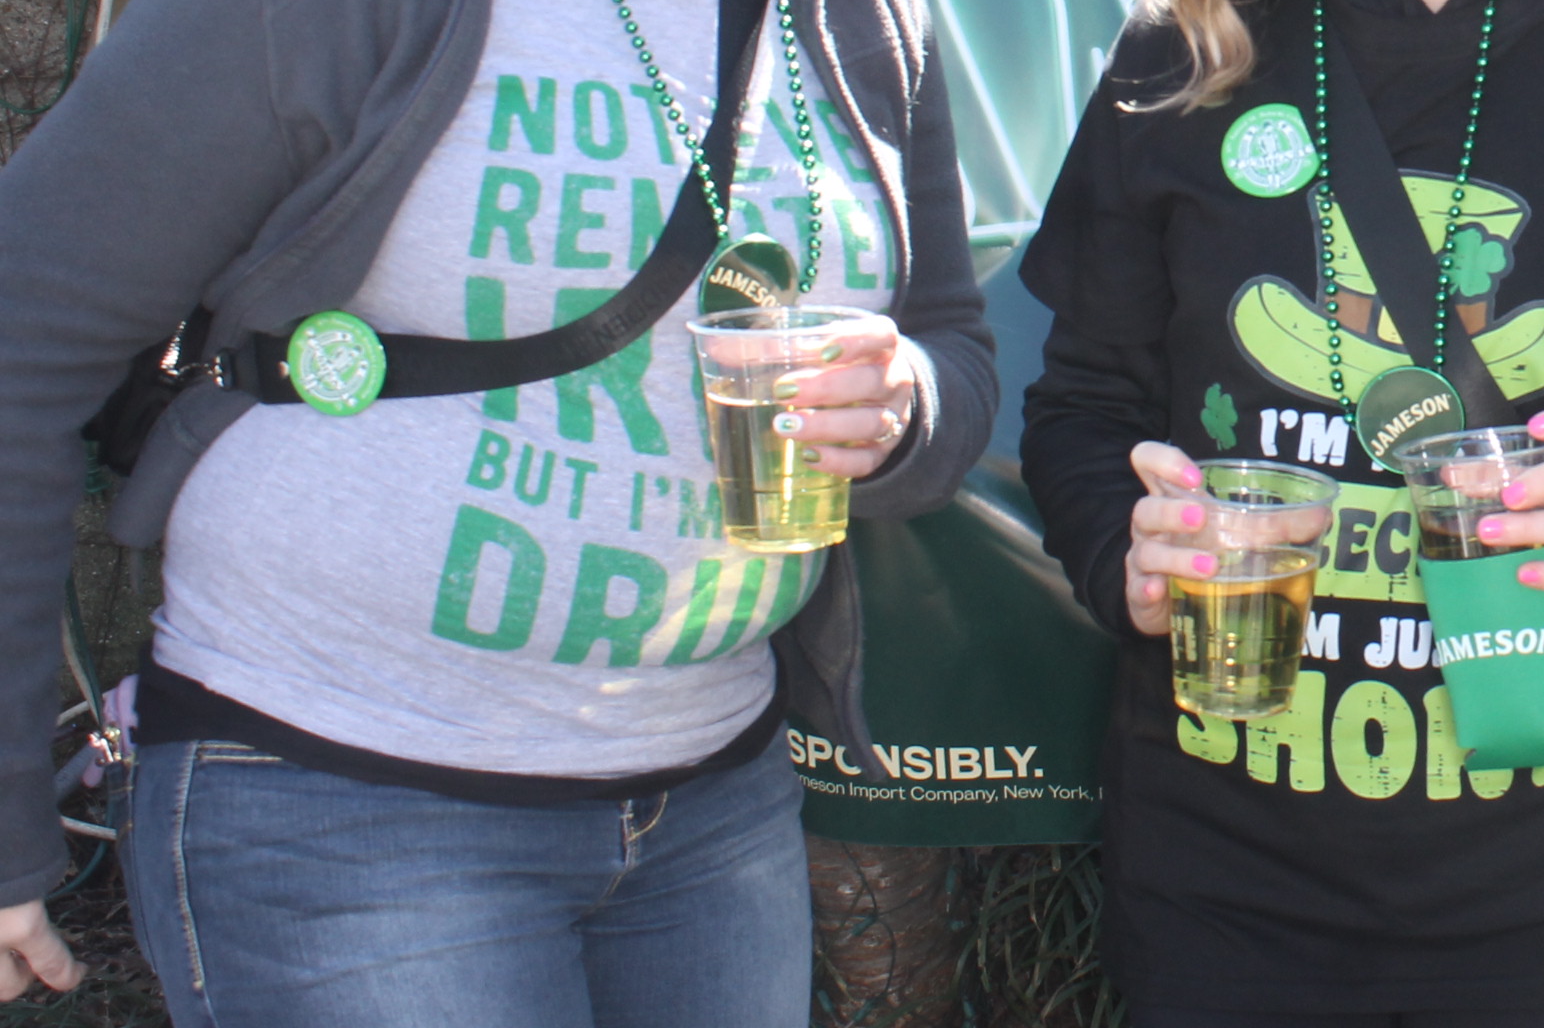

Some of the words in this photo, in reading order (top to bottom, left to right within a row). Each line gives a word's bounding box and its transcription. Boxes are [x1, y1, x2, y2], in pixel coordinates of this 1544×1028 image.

[488, 74, 676, 165] NOT
[709, 266, 781, 313] JAMESO
[1260, 408, 1350, 466] I'M
[1371, 393, 1452, 458] JAMESON
[466, 428, 598, 520] BUT
[629, 471, 724, 539] I'M
[849, 781, 907, 802] Import
[910, 785, 998, 804] Company,
[1003, 784, 1044, 800] New
[1048, 784, 1094, 802] York,
